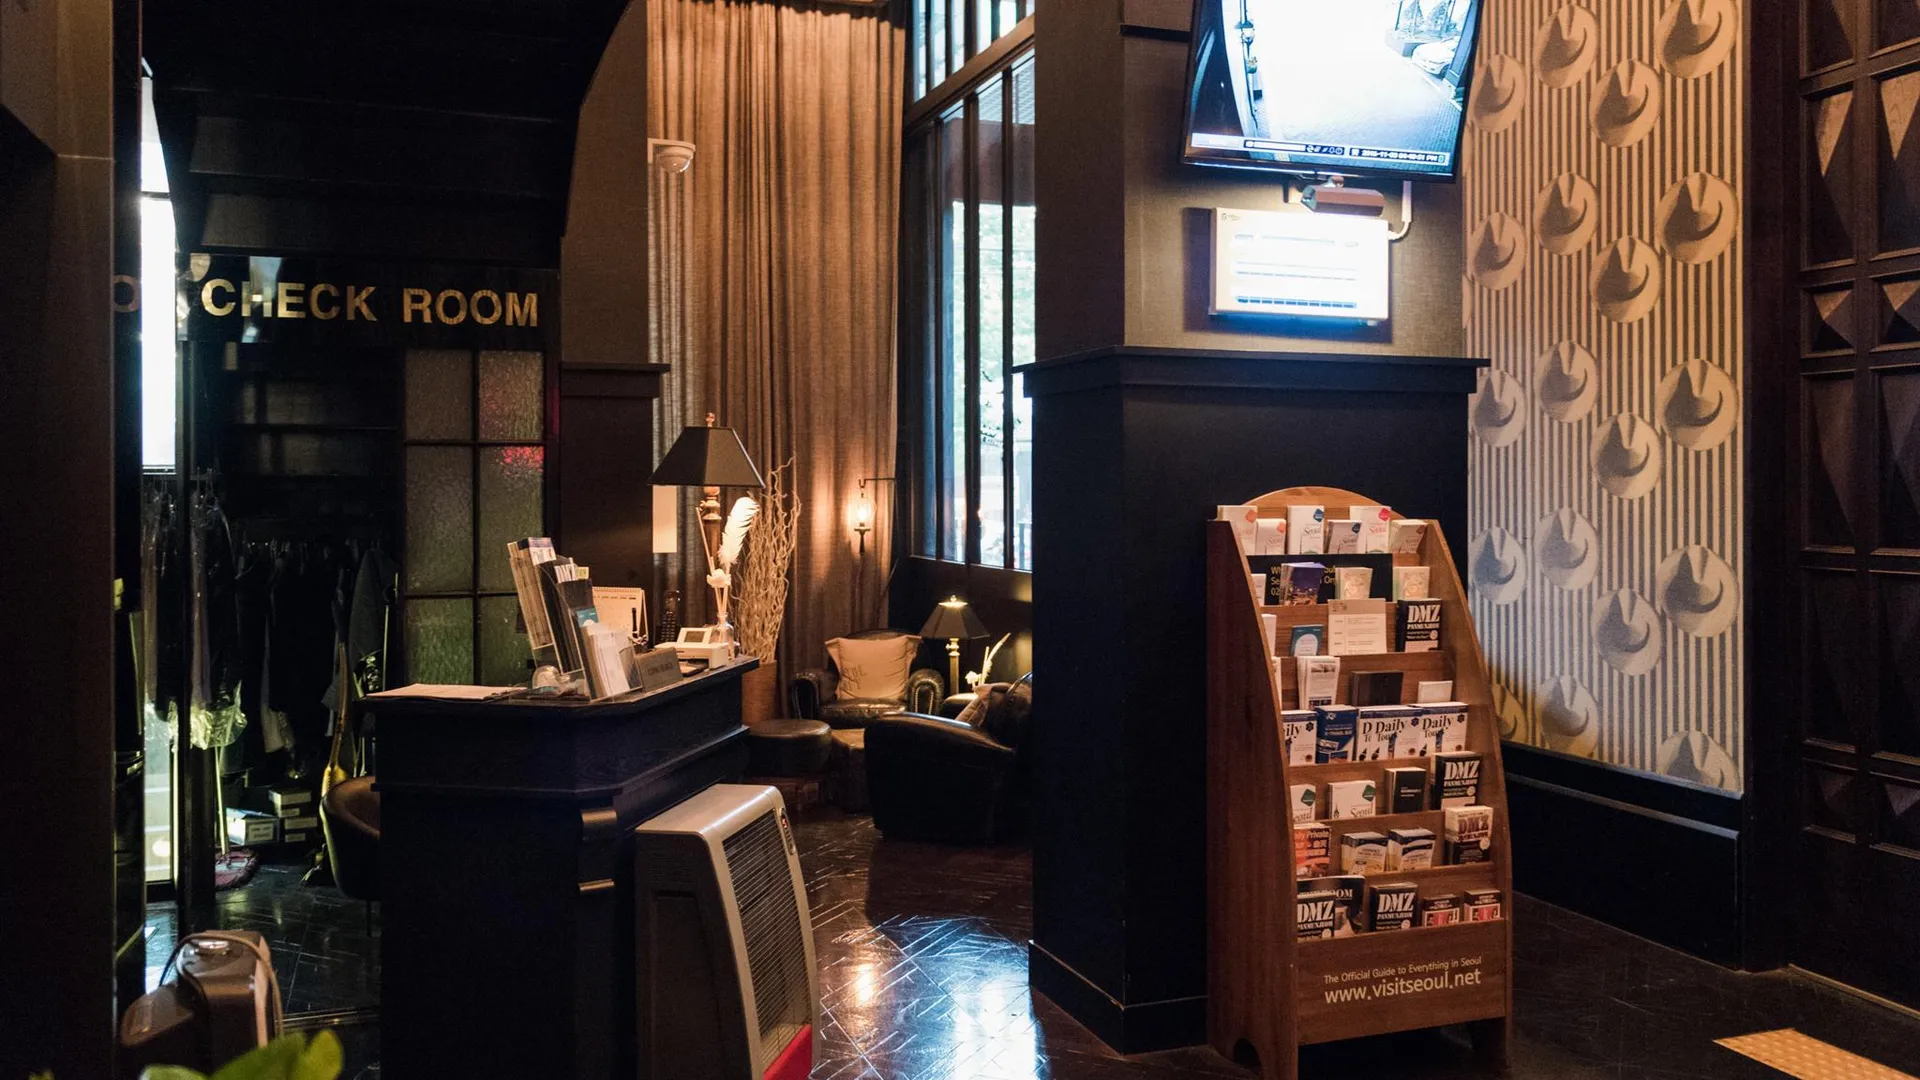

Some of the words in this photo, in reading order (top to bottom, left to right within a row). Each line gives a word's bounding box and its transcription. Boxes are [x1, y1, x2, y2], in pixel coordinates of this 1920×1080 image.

[201, 278, 377, 321] CHECK
[403, 287, 539, 328] ROOM
[1407, 604, 1441, 623] DMZ
[1375, 718, 1407, 734] Daily
[1422, 714, 1454, 730] Daily
[1444, 760, 1480, 780] DMZ
[1294, 806, 1313, 822] eoul
[1458, 814, 1489, 834] DMZ
[1297, 900, 1334, 923] DMZ
[1377, 892, 1415, 913] DMZ
[1323, 974, 1339, 984] The
[1341, 969, 1371, 982] Official
[1372, 966, 1396, 978] Guide
[1397, 966, 1407, 975] to
[1408, 960, 1449, 975] Everything
[1451, 959, 1459, 967] in
[1461, 955, 1482, 967] Seoul
[1324, 967, 1482, 1004] www.visitseoul.net
